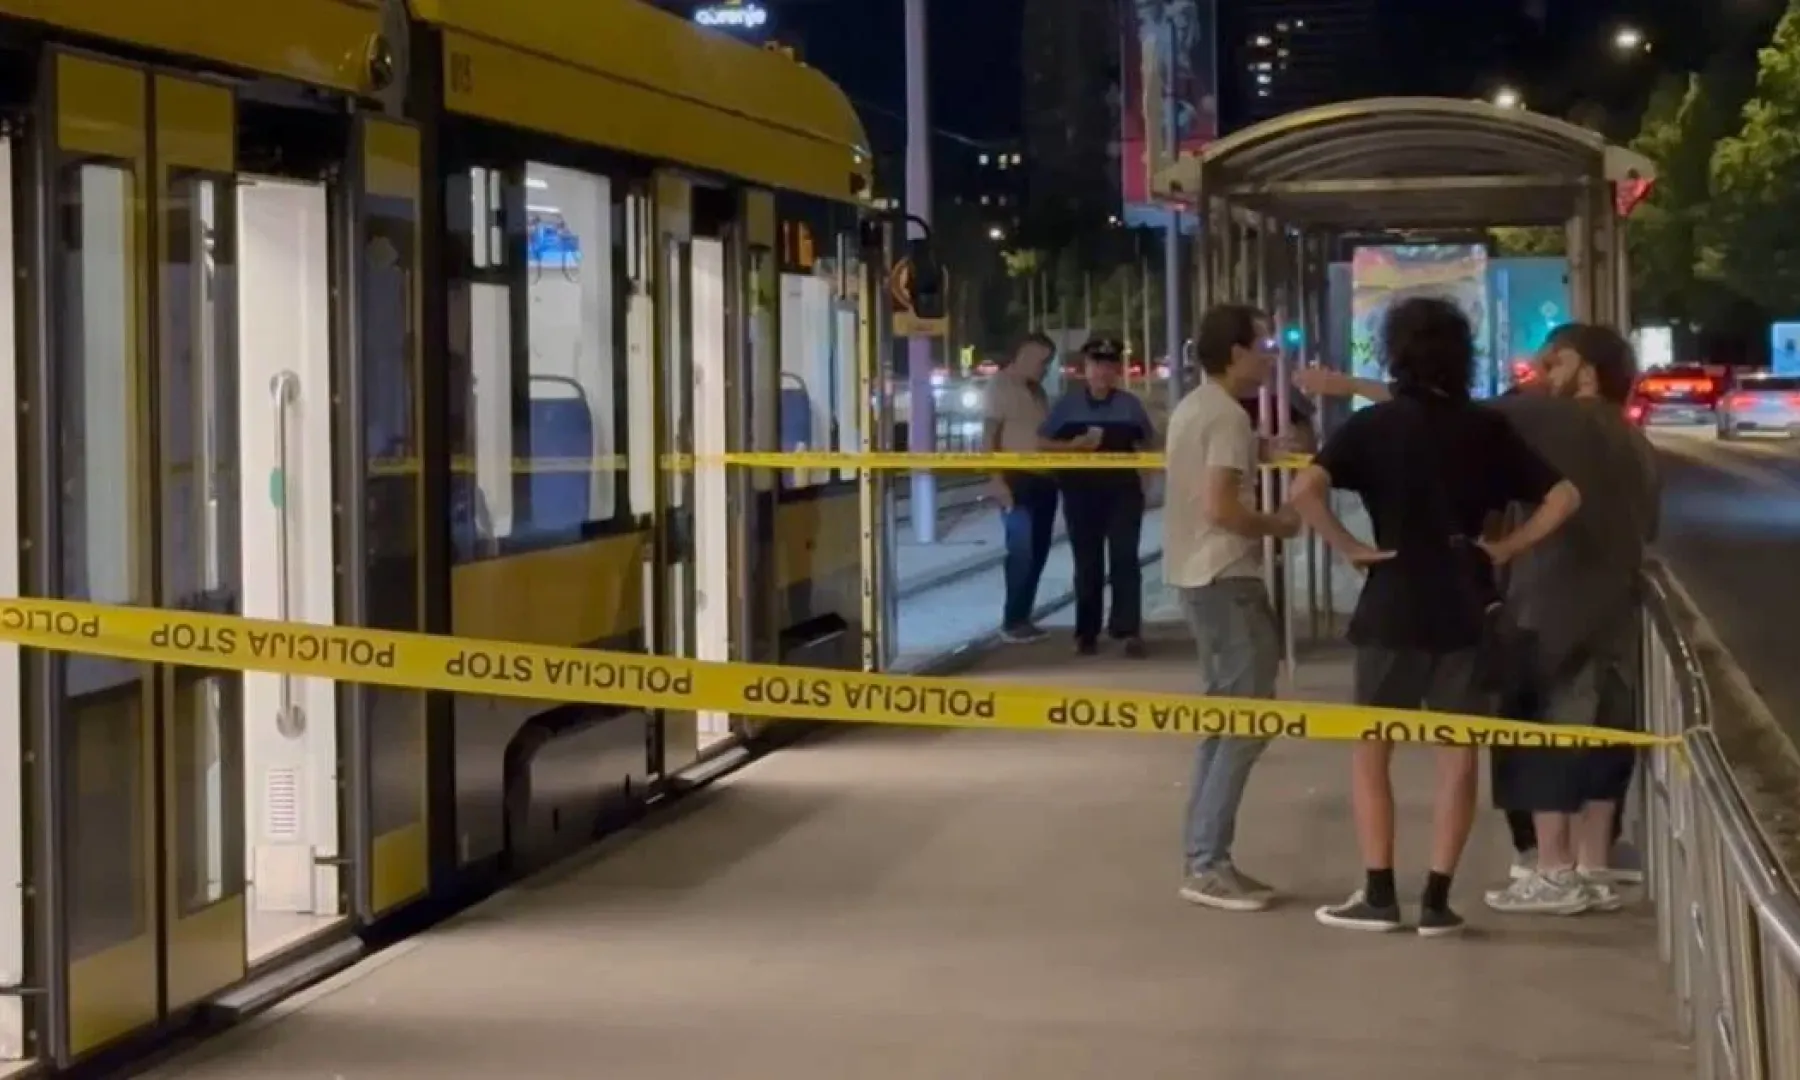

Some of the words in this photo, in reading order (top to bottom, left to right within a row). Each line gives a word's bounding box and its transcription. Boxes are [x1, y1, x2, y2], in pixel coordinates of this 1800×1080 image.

[151, 623, 236, 653] STOP
[248, 631, 395, 668] POLICIJA
[446, 651, 532, 682] STOP
[544, 657, 692, 694] POLICIJA
[743, 676, 831, 707] STOP
[844, 682, 996, 718] POLICIJA
[1048, 697, 1138, 729] STOP
[1150, 704, 1306, 737] POLICIJA
[1361, 720, 1455, 746] STOP
